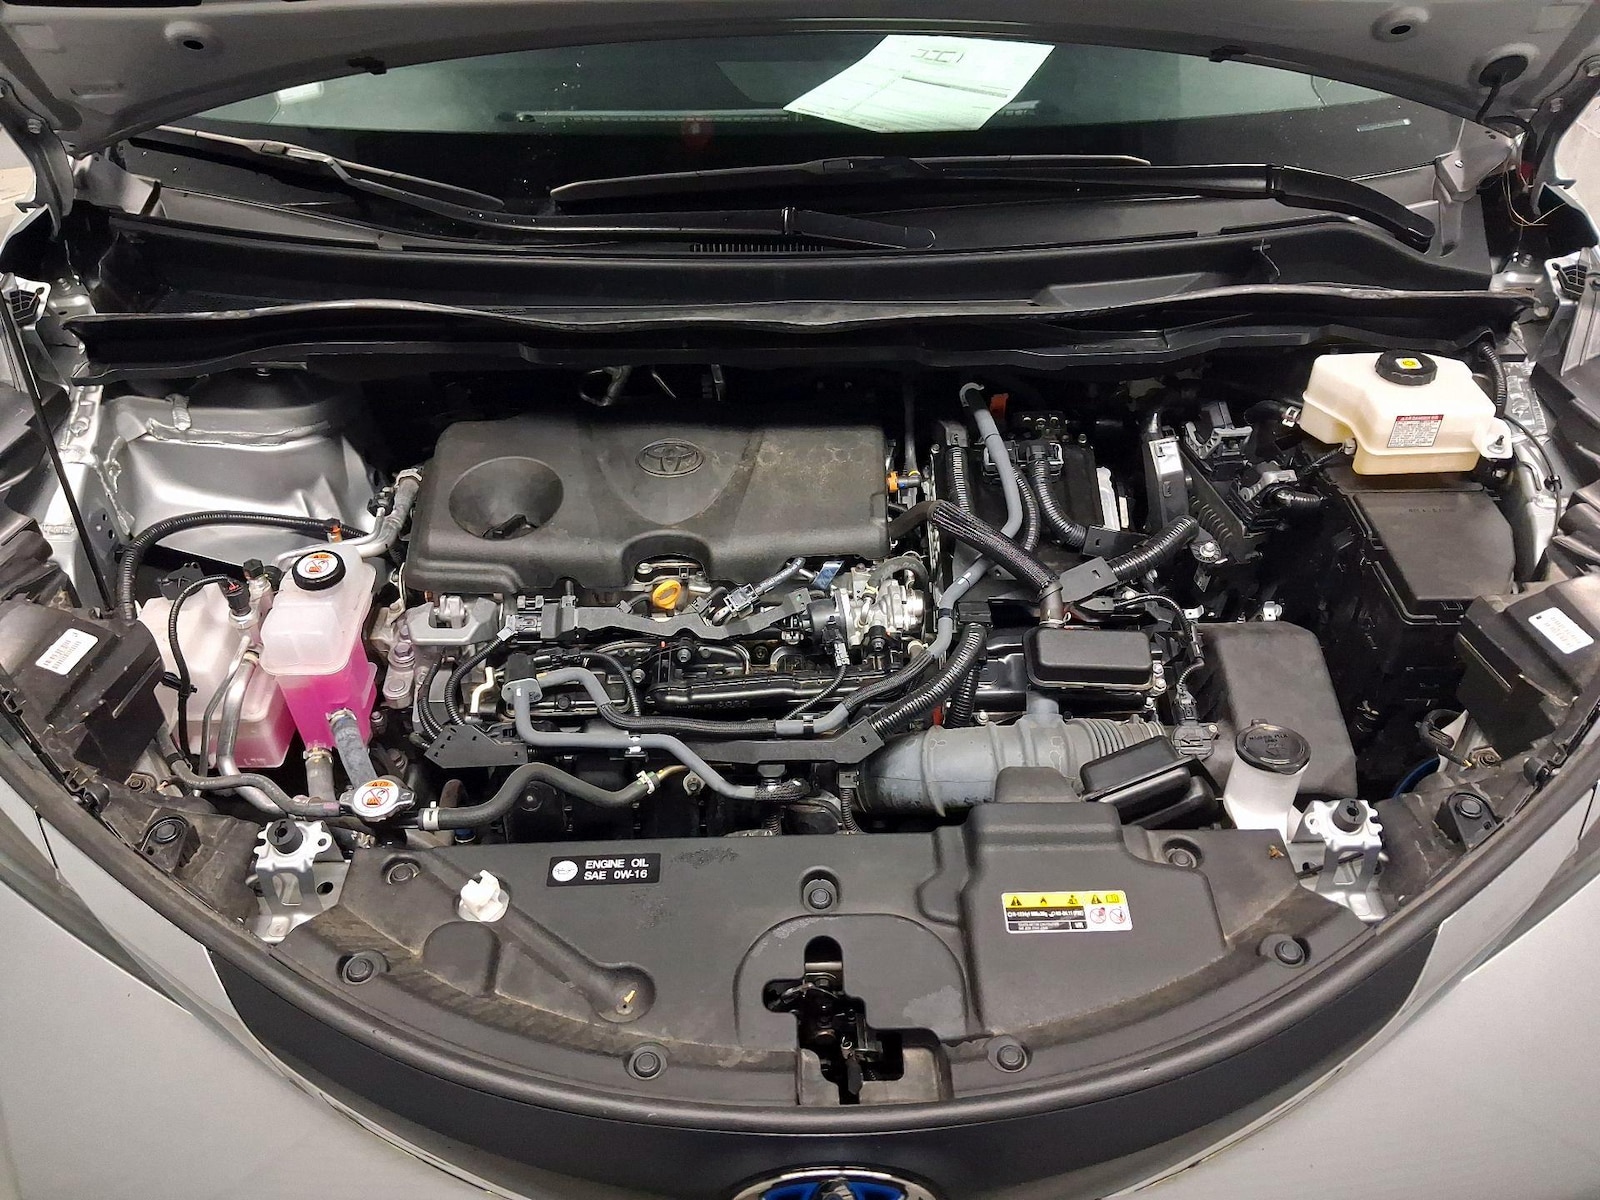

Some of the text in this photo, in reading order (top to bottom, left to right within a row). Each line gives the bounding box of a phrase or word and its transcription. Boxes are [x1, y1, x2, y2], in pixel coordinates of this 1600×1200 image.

[585, 858, 649, 869] ENGINE OIL
[584, 870, 648, 880] SAE 0W-16
